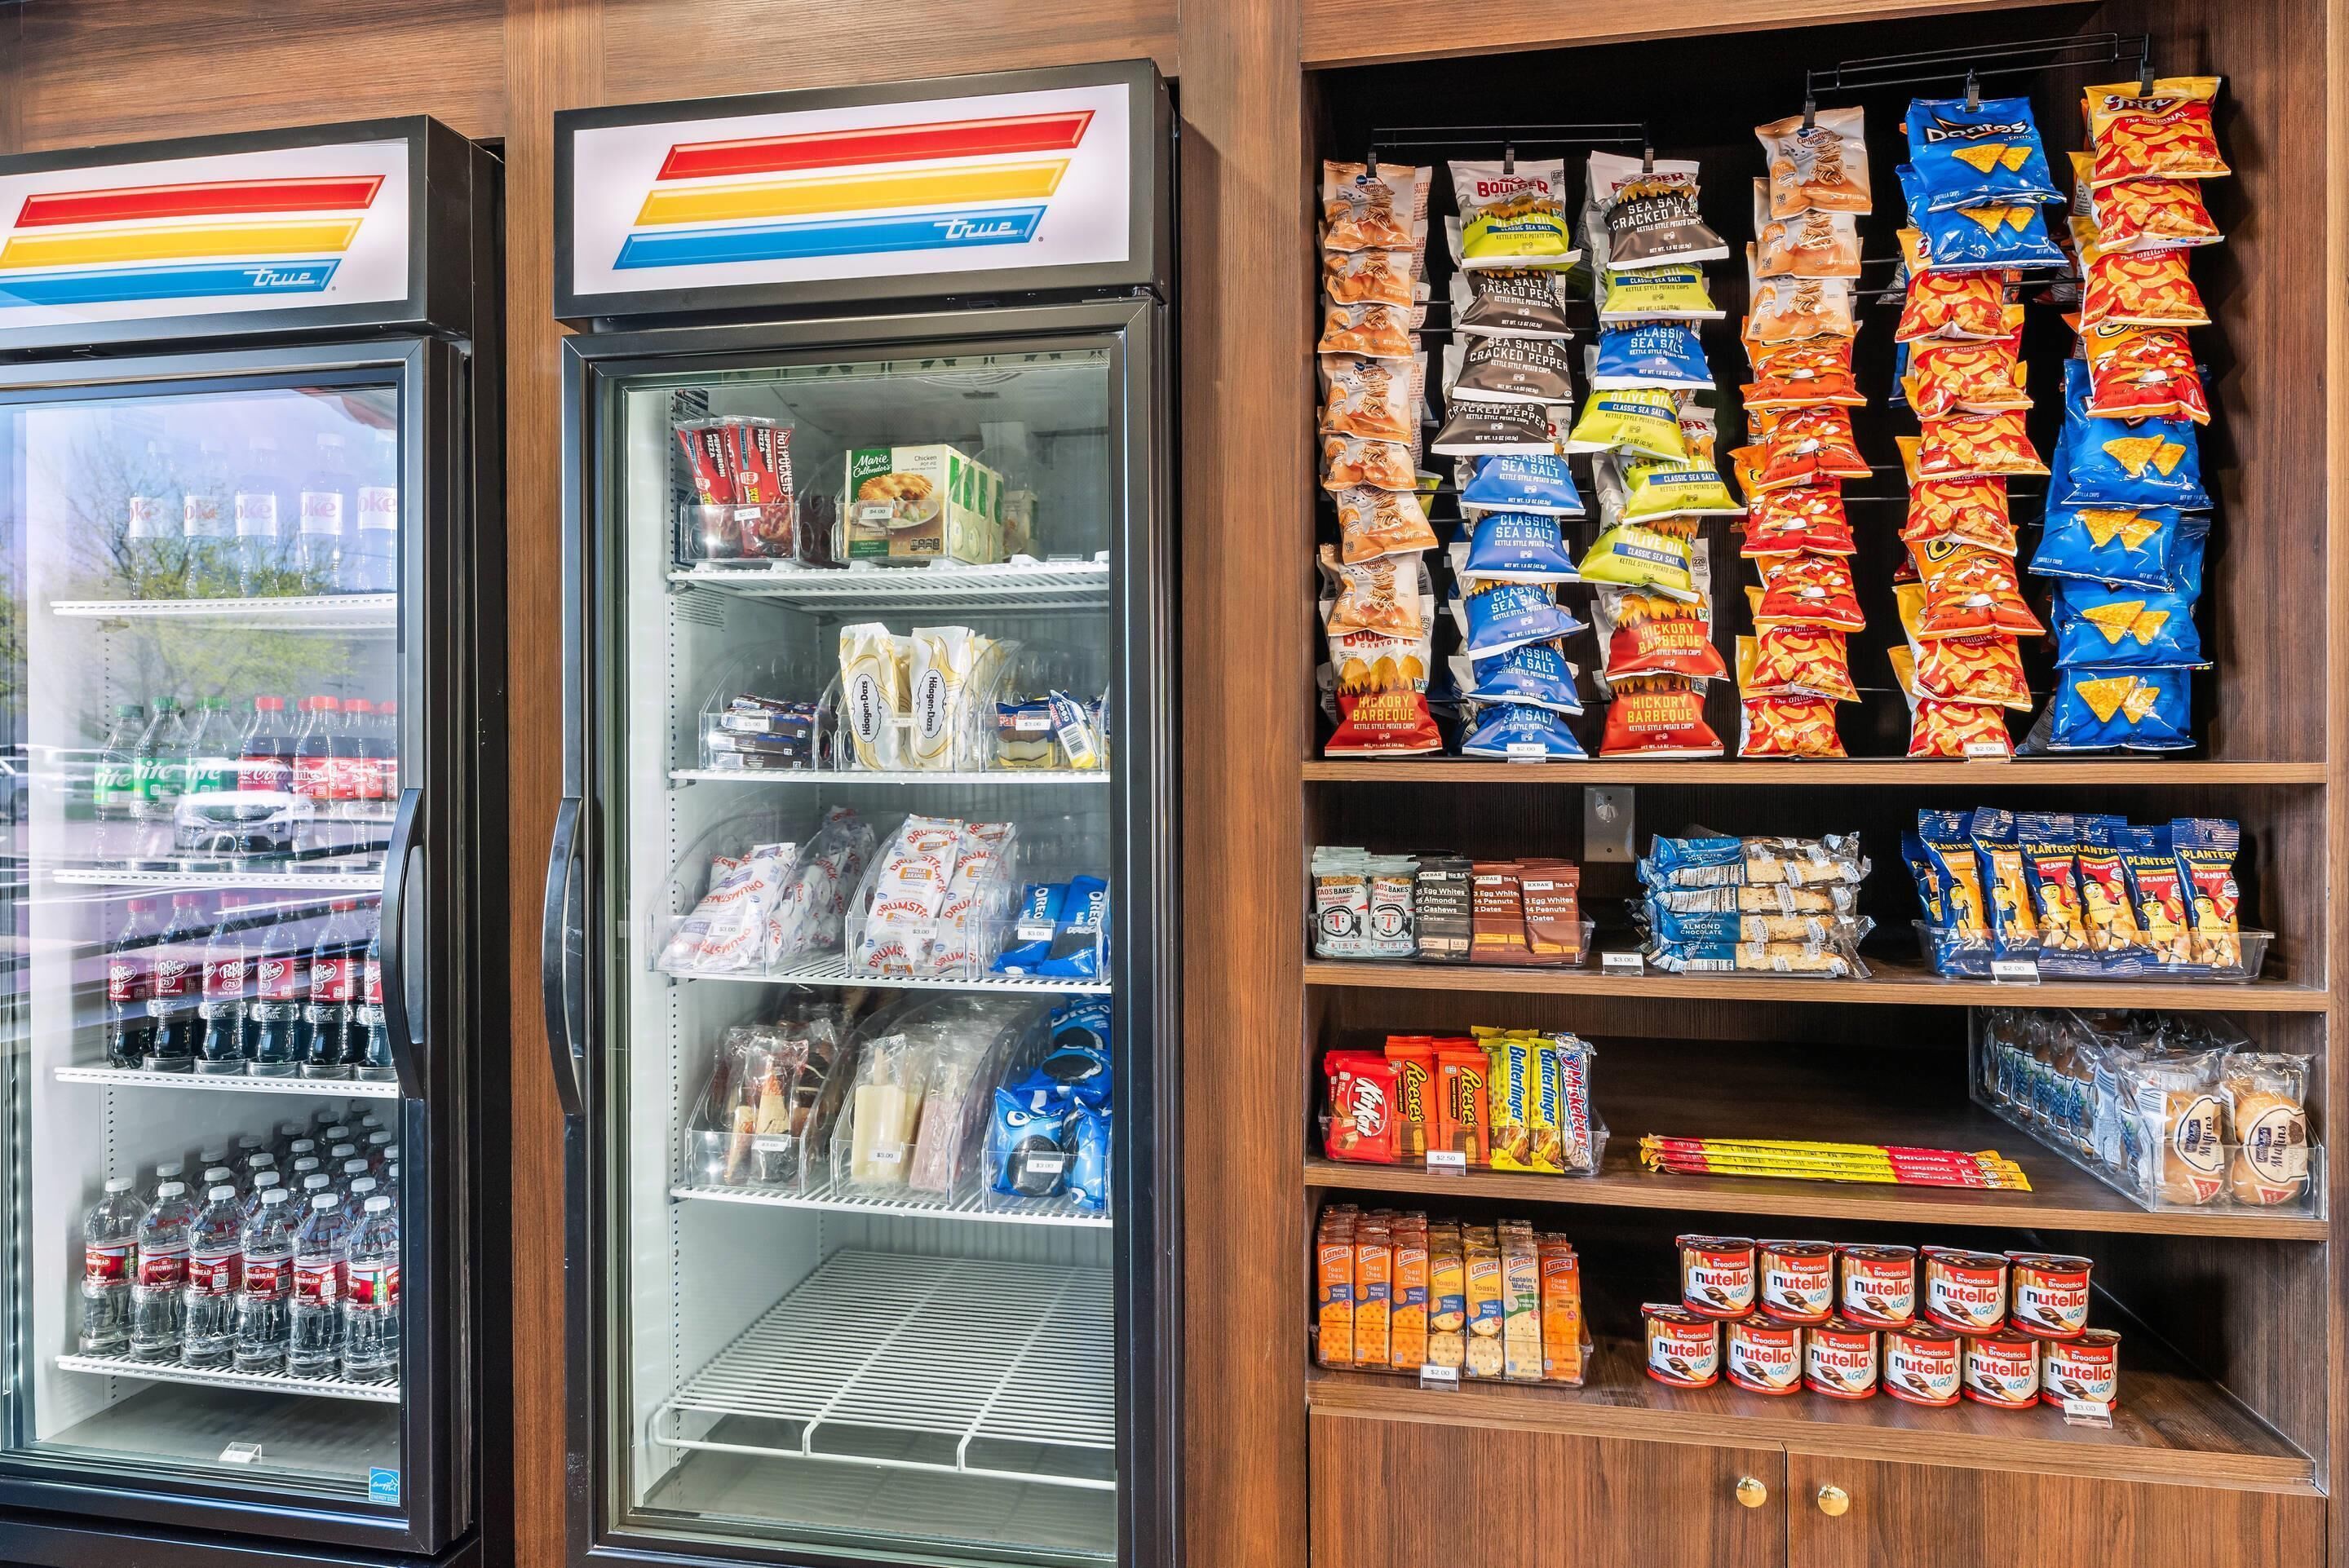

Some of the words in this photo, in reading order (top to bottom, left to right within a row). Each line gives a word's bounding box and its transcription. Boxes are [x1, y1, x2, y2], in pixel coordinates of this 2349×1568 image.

[1927, 121, 2028, 143] Doritos
[1476, 179, 1549, 197] BOULDER
[1627, 201, 1652, 214] SEA
[934, 219, 1019, 240] true
[1612, 210, 1669, 232] CRACKED
[243, 268, 316, 286] true
[1488, 338, 1511, 348] SEA
[1516, 339, 1544, 353] SALT
[1547, 347, 1555, 356] &
[1631, 338, 1657, 348] SEA
[1661, 339, 1683, 355] SALT
[1470, 347, 1524, 362] CRACKED
[1528, 350, 1568, 373] PEPPER
[1612, 404, 1637, 413] CLASSIC
[1638, 406, 1650, 414] SEA
[1652, 408, 1666, 417] SALT
[706, 435, 714, 458] PIZZA
[713, 433, 726, 477] PEPPERONI
[764, 429, 773, 473] PEPPERONI
[854, 454, 888, 468] Marie
[1502, 460, 1525, 473] SEA
[1530, 462, 1559, 478] SALT
[853, 464, 892, 478] Callender's
[1664, 474, 1686, 483] CLASSIC
[1500, 515, 1551, 529] CLASSIC
[1496, 527, 1520, 538] SEA
[1524, 528, 1555, 541] SALT
[1625, 531, 1661, 550] OLIVE
[1666, 541, 1683, 555] OIL
[1627, 547, 1651, 559] CLASSIC
[1652, 553, 1664, 561] SEA
[1666, 555, 1679, 565] SALT
[1641, 623, 1695, 639] HICKORY
[1638, 635, 1701, 654] BARBEQUE
[1359, 696, 1409, 708] HICKORY
[1632, 696, 1687, 709] HICKORY
[1353, 709, 1414, 723] BARBEQUE
[1627, 709, 1693, 723] BARBEQUE
[2027, 845, 2076, 855] PLANTERS
[2183, 850, 2237, 860] PLANTERS
[2083, 861, 2118, 871] PEANUTS
[2143, 875, 2178, 883] PEANUTS
[1033, 888, 1048, 919] OREO
[158, 962, 186, 977] Pepper
[1561, 1055, 1579, 1069] 3
[1405, 1061, 1428, 1122] Reese's
[1508, 1045, 1527, 1123] Butterfinger
[1540, 1049, 1556, 1126] Butterfinger
[1460, 1066, 1483, 1128] Reese's
[2199, 1116, 2217, 1156] Muffins
[2271, 1125, 2286, 1167] Muffins
[1323, 1248, 1347, 1260] Lance
[1361, 1247, 1386, 1257] Lance
[1400, 1250, 1424, 1262] Lance
[1471, 1264, 1497, 1274] Lance
[1509, 1257, 1533, 1268] Lance
[1546, 1261, 1570, 1271] Lance
[1509, 1275, 1537, 1283] Captain's
[1696, 1271, 1749, 1287] nutella
[1773, 1274, 1827, 1290] nutella
[1855, 1279, 1909, 1296] nutella
[1730, 1285, 1750, 1299] &GO!
[1936, 1284, 1997, 1303] nutella
[2026, 1289, 2085, 1306] nutella
[1659, 1340, 1712, 1357] nutella
[1736, 1343, 1790, 1363] nutella
[1811, 1349, 1868, 1368] nutella
[1895, 1355, 1953, 1375] nutella
[1969, 1356, 2029, 1376] nutella
[1768, 1362, 1792, 1376] &GO!
[2050, 1361, 2111, 1381] nutella
[1931, 1373, 1954, 1388] &GO!
